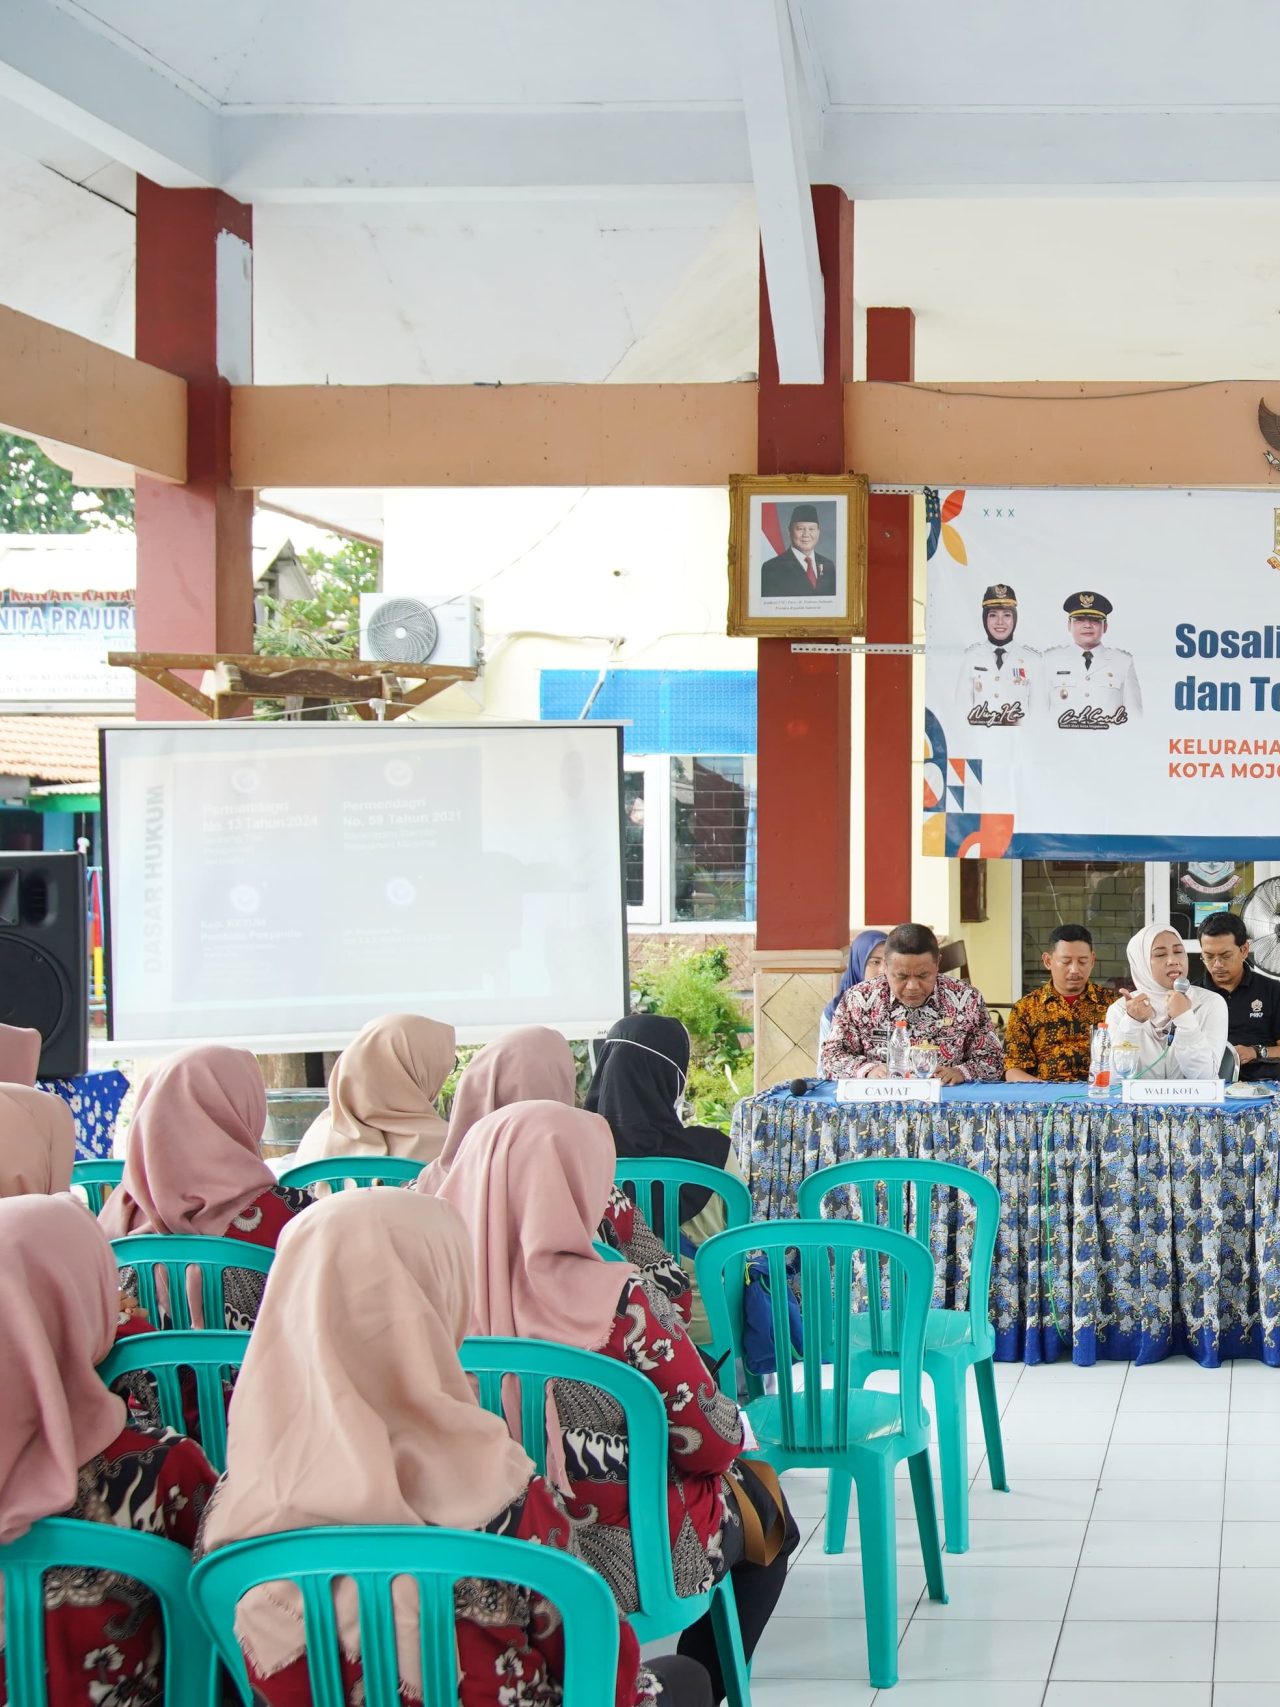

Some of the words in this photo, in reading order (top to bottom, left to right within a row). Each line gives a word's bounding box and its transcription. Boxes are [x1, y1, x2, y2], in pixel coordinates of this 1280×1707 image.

[1174, 675, 1241, 711] dan
[1168, 762, 1225, 778] KOTA
[143, 784, 165, 880] HUKUM
[864, 1087, 911, 1097] CAMAT
[1144, 1087, 1169, 1095] WALI
[1172, 1087, 1200, 1095] KOTA
